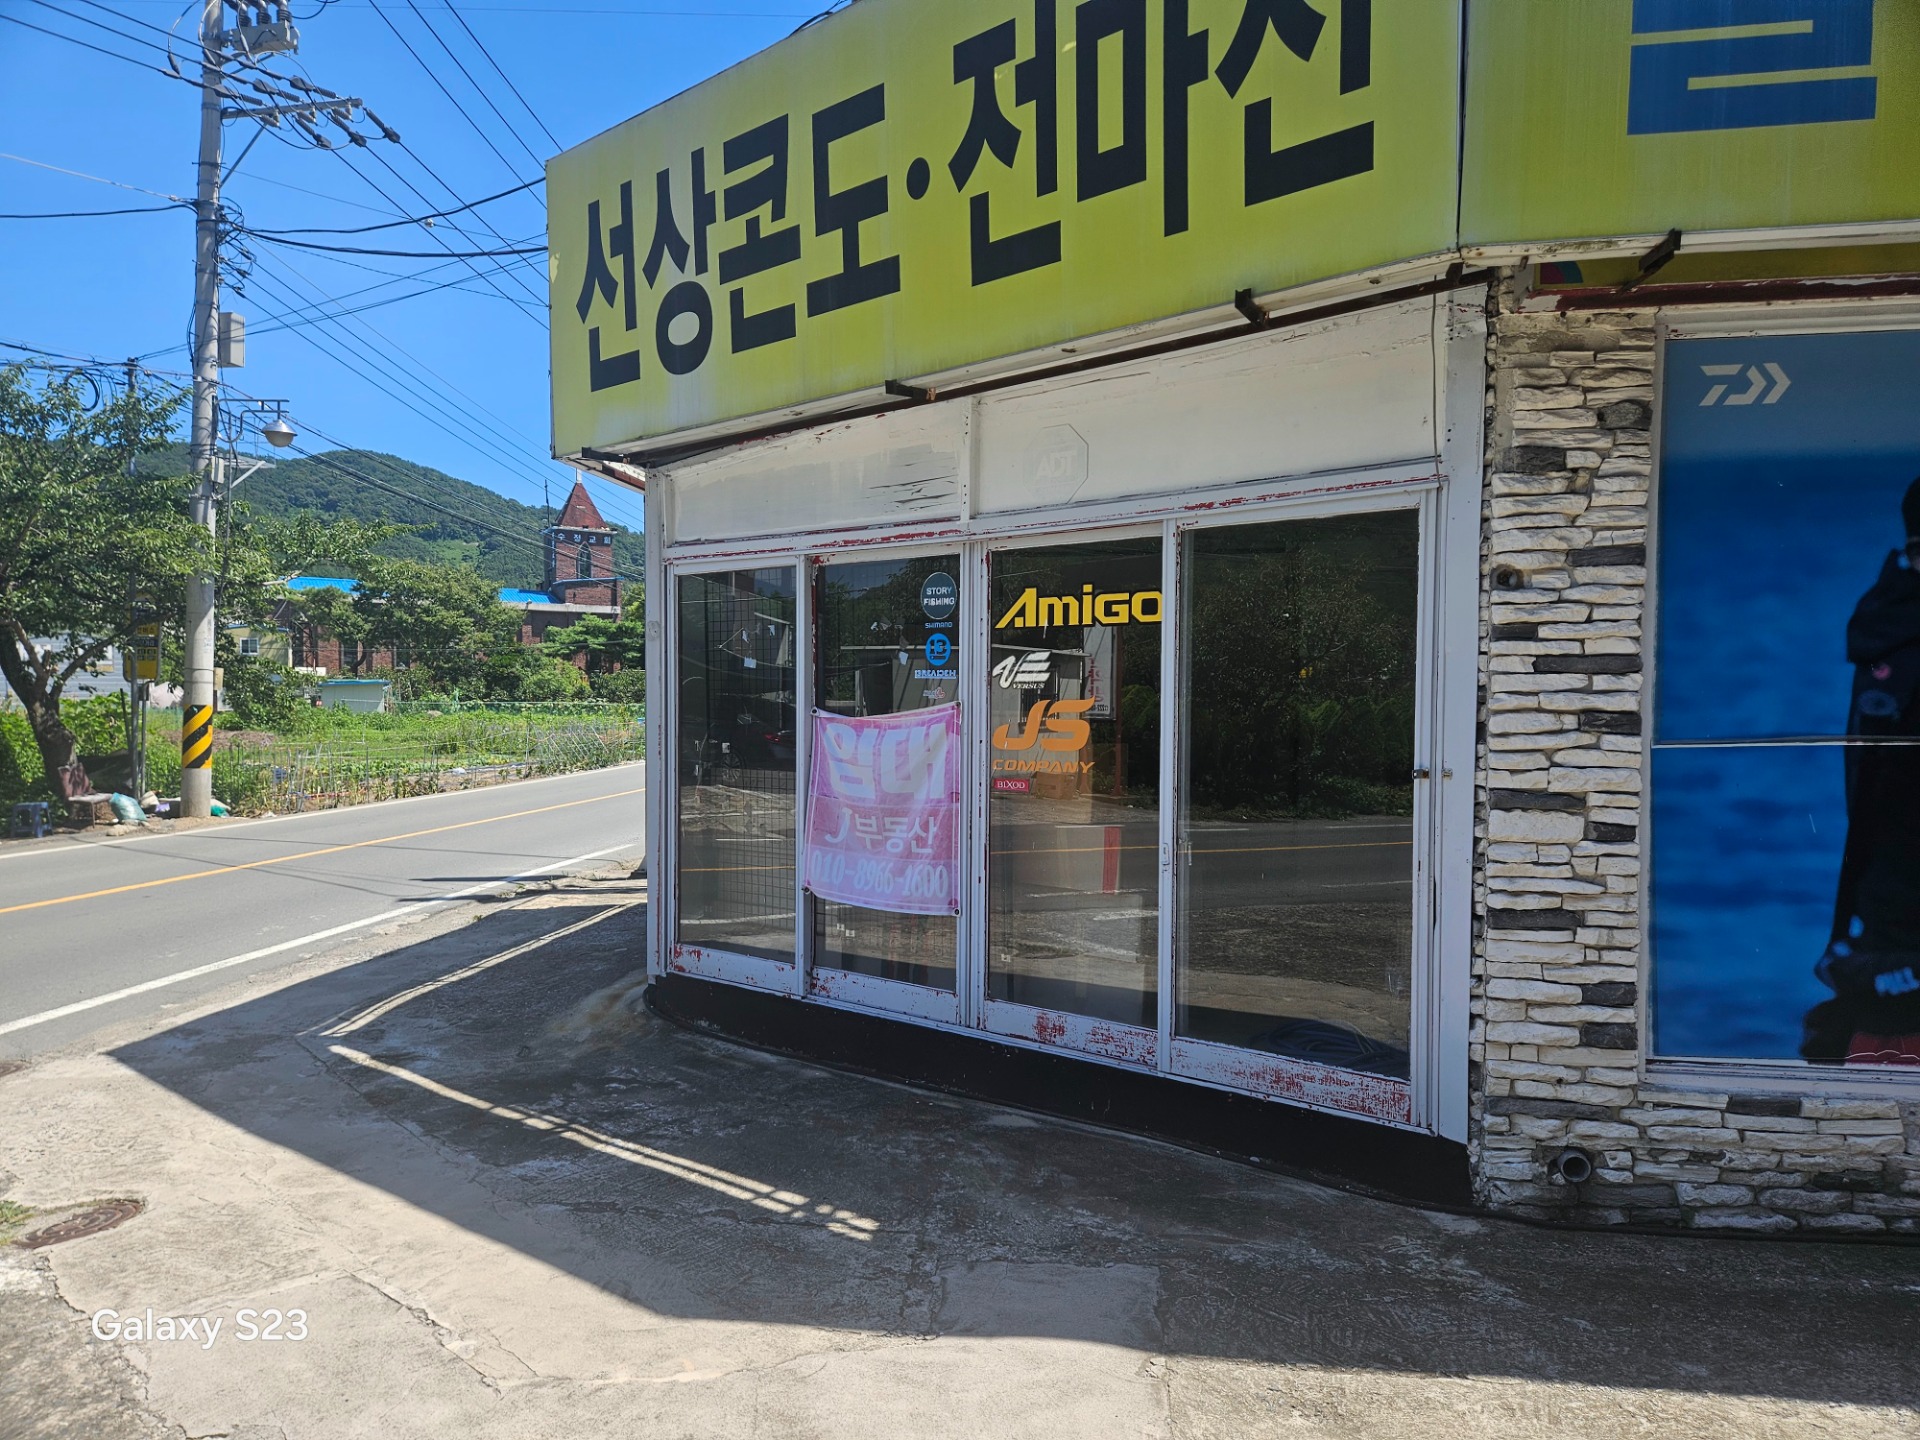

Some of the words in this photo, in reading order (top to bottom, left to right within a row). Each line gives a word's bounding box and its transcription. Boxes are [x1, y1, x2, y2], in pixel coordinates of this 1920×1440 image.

[557, 532, 611, 545] 수정교회
[926, 586, 952, 595] STORY
[923, 597, 955, 606] FISHING
[925, 621, 953, 629] SHIMANO
[992, 695, 1096, 751] JS
[823, 722, 948, 801] 임대
[991, 759, 1096, 774] COMPANY
[997, 780, 1026, 789] BIXOD
[824, 807, 853, 843] J
[854, 813, 938, 854] 부동산
[810, 850, 949, 898] 010-8966-1600
